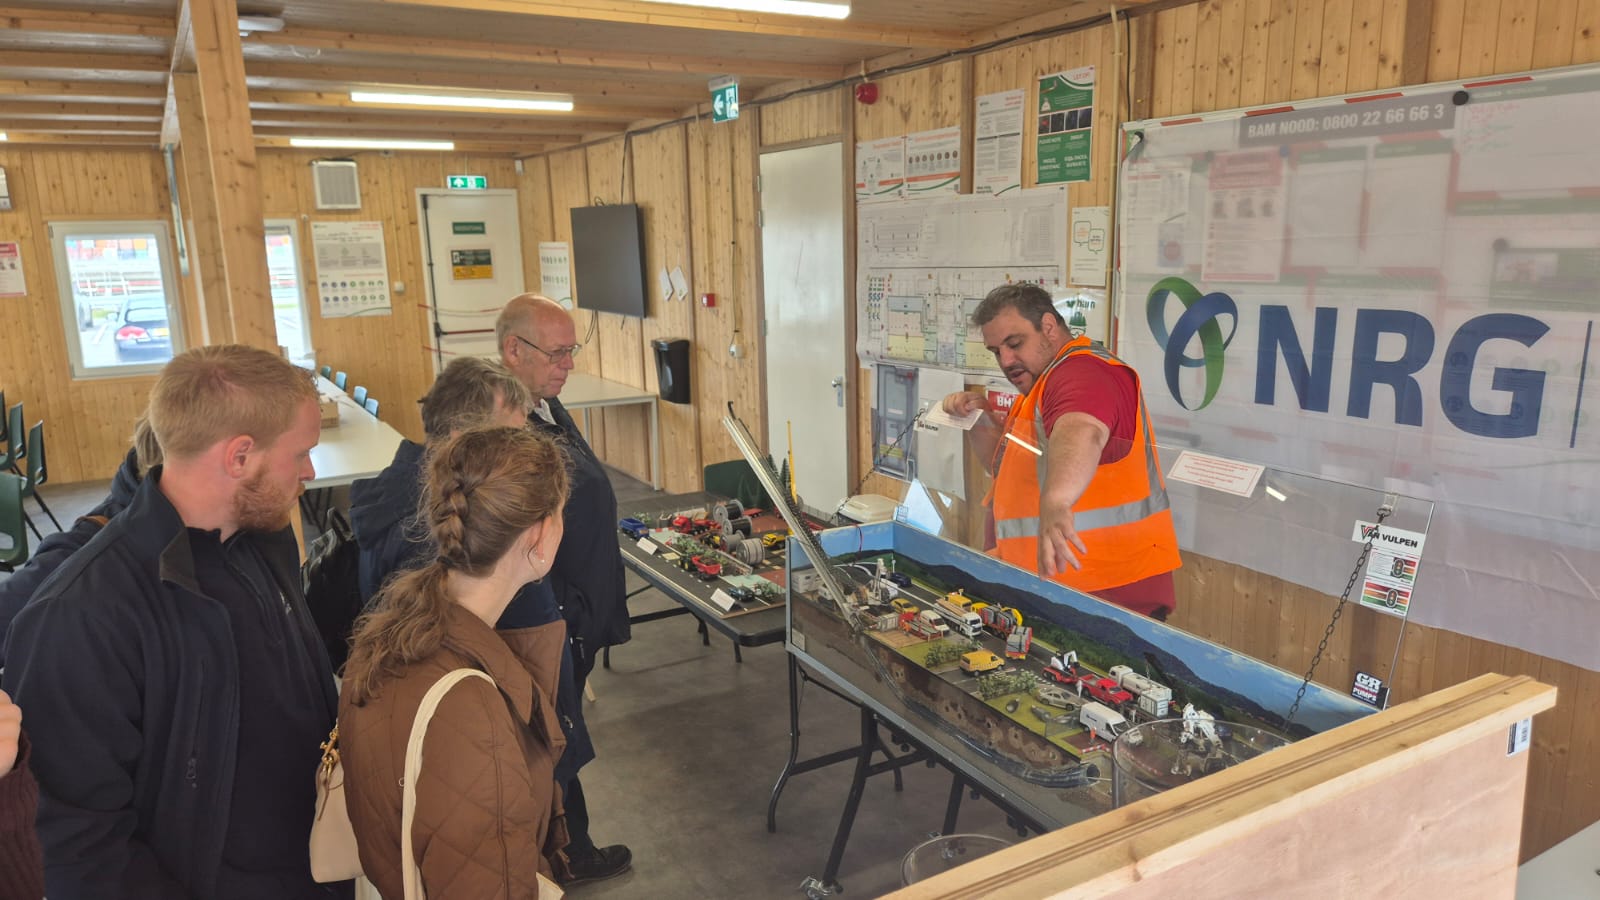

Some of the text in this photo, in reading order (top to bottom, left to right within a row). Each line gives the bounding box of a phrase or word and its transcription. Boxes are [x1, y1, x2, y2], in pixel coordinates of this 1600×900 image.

[1248, 103, 1444, 138] BAM NOOD: 0800 22 66 66 3
[1254, 304, 1551, 439] NRG
[1360, 524, 1418, 548] VAN VULPEN
